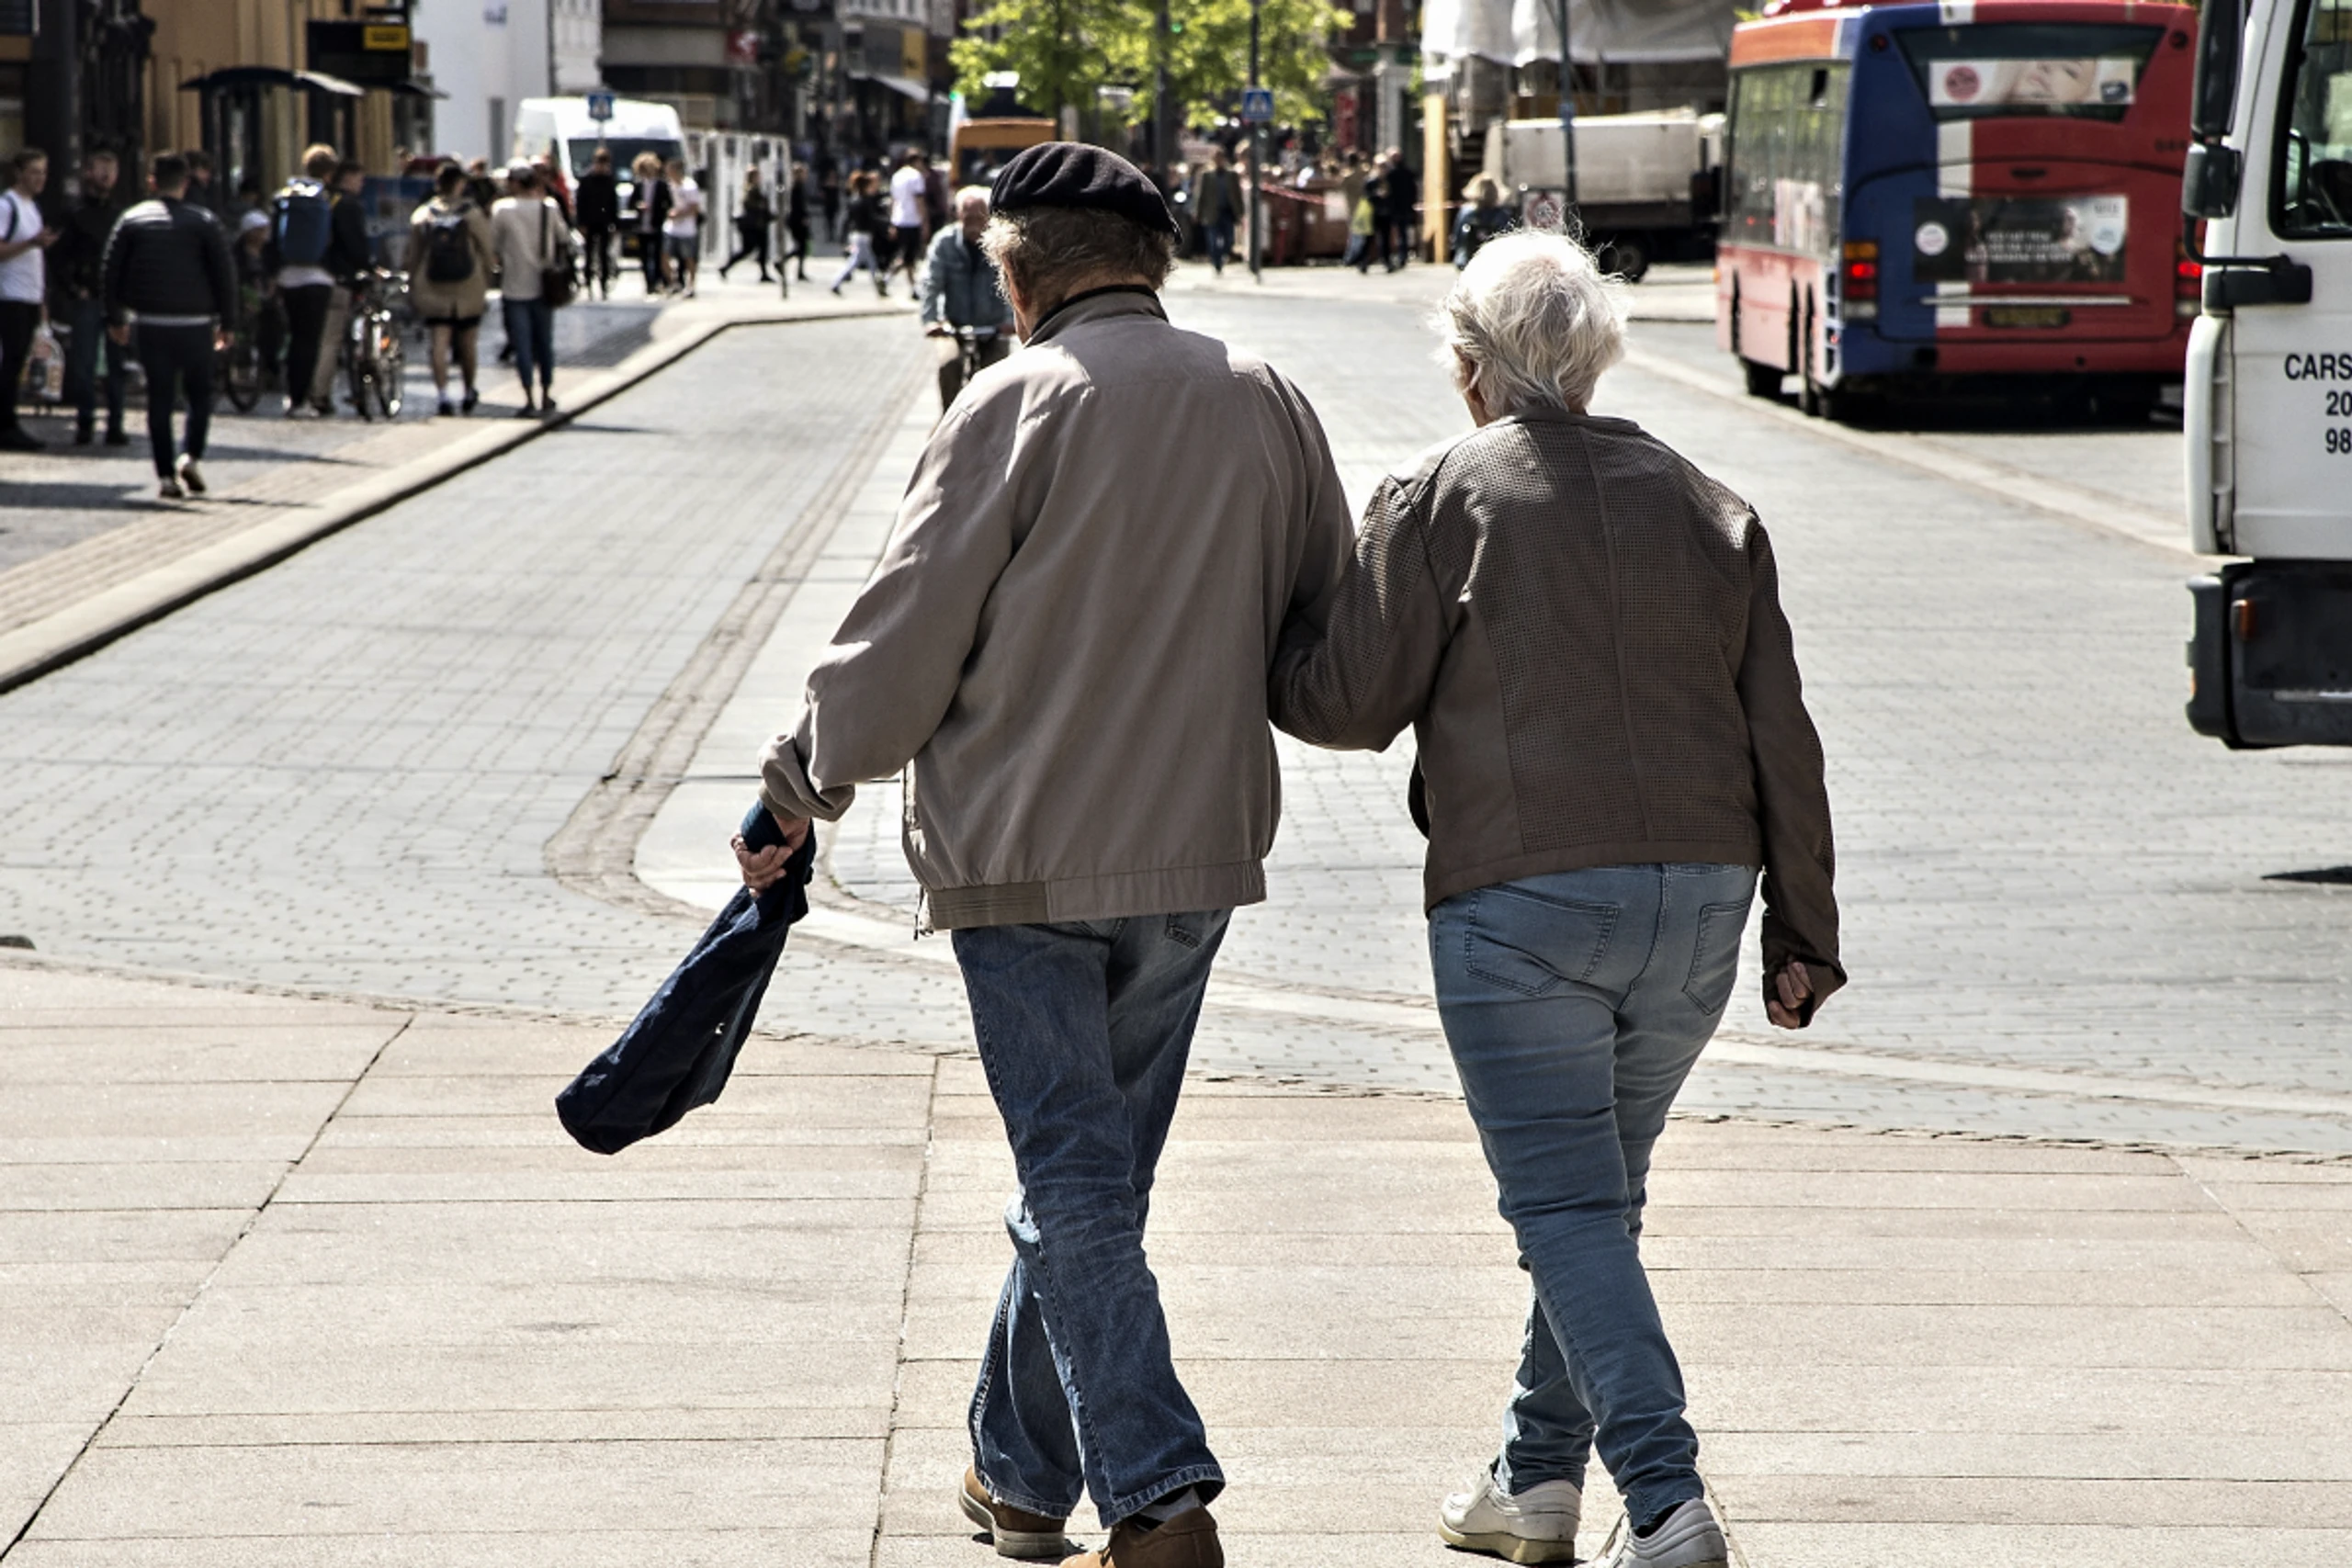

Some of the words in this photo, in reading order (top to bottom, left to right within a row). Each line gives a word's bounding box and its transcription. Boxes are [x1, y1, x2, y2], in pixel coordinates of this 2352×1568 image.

[2284, 353, 2352, 380] CARS
[2325, 390, 2352, 417] 20
[2325, 427, 2352, 454] 98
